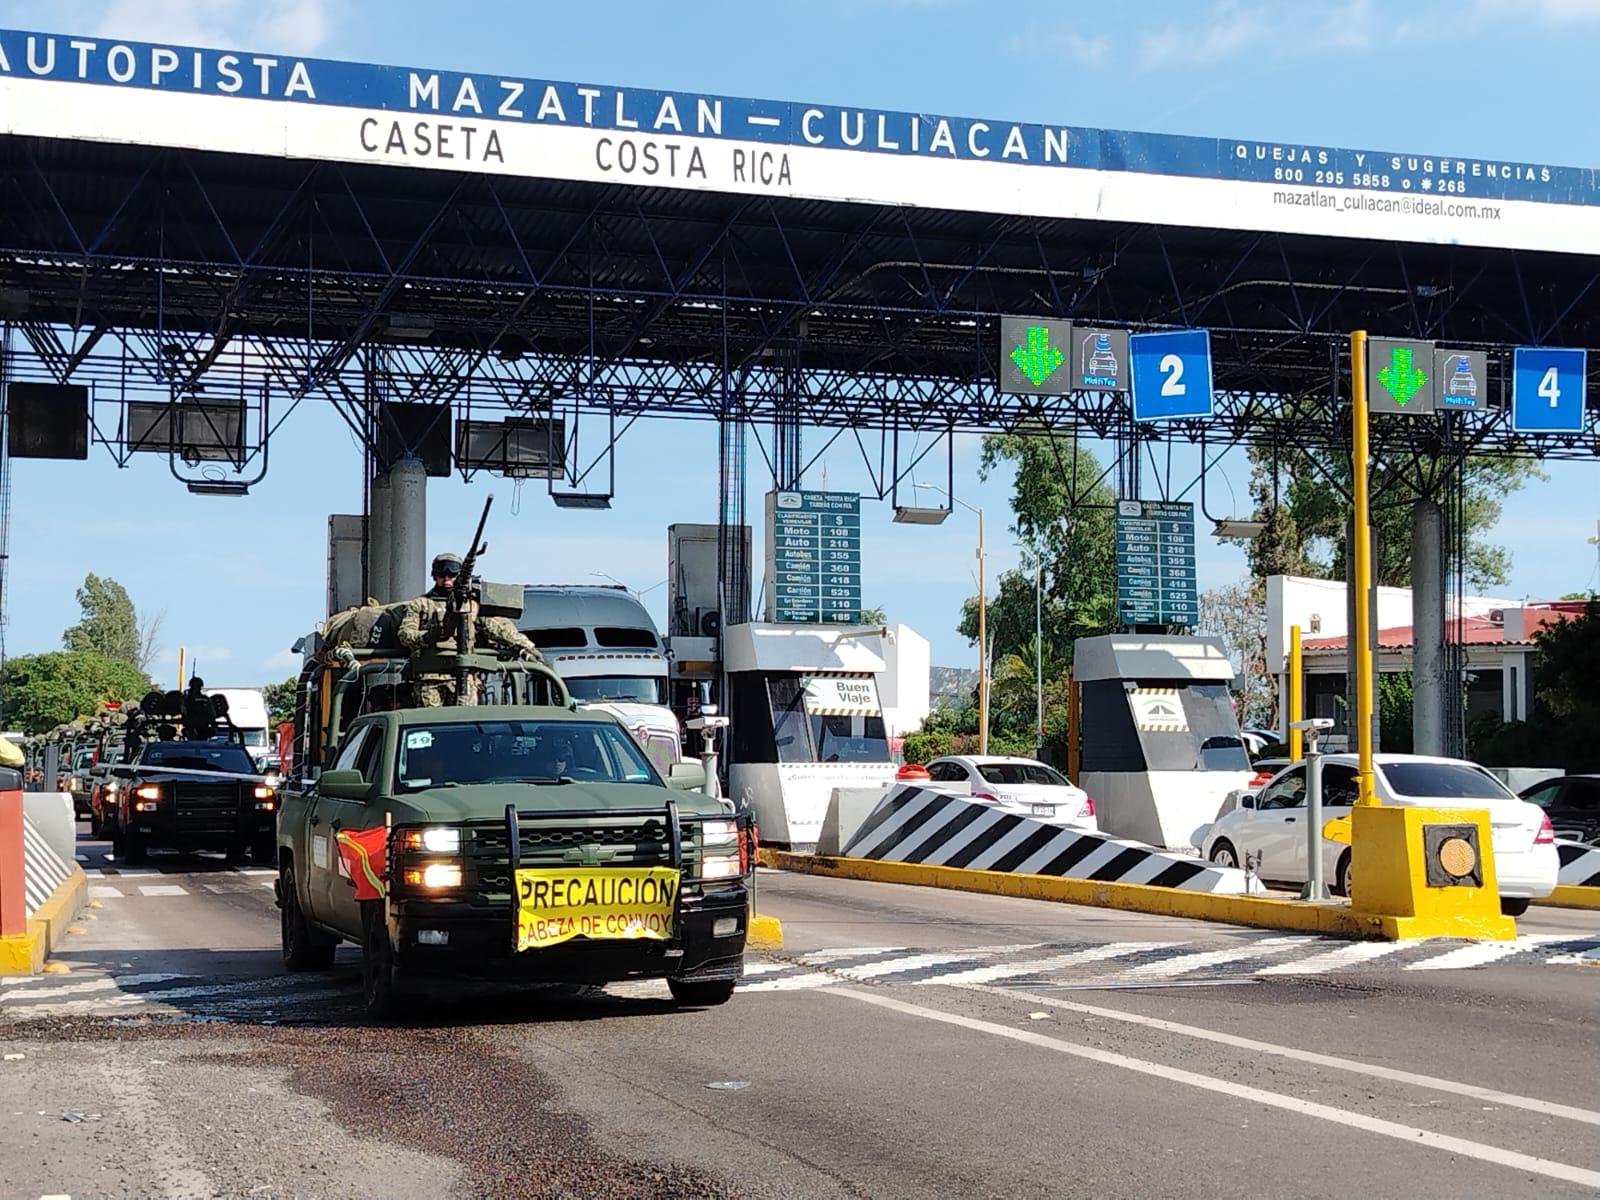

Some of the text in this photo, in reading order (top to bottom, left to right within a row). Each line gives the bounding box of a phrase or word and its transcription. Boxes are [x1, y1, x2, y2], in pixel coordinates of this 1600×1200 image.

[409, 72, 722, 135] MAZATLAN
[801, 109, 1068, 163] CULIACAN
[359, 118, 792, 186] CASETA COSTA RICA
[1236, 145, 1550, 182] QUEJAS Y SUGERENCIAS
[1274, 168, 1303, 181] 800
[1315, 171, 1344, 184] 295
[1352, 173, 1390, 187] 5858
[1273, 191, 1501, 220] mazatlan_culiacan@ideal.com.mx
[1160, 354, 1186, 397] 2
[1538, 367, 1561, 408] 4
[784, 527, 810, 535] Moto
[785, 538, 810, 546] Auto
[1126, 544, 1150, 552] Auto
[1170, 603, 1188, 611] 110
[371, 624, 382, 644] 232
[836, 681, 870, 692] Buen
[838, 692, 871, 705] Viaje
[521, 871, 674, 909] PRECAUCIÓN
[581, 915, 601, 935] DE
